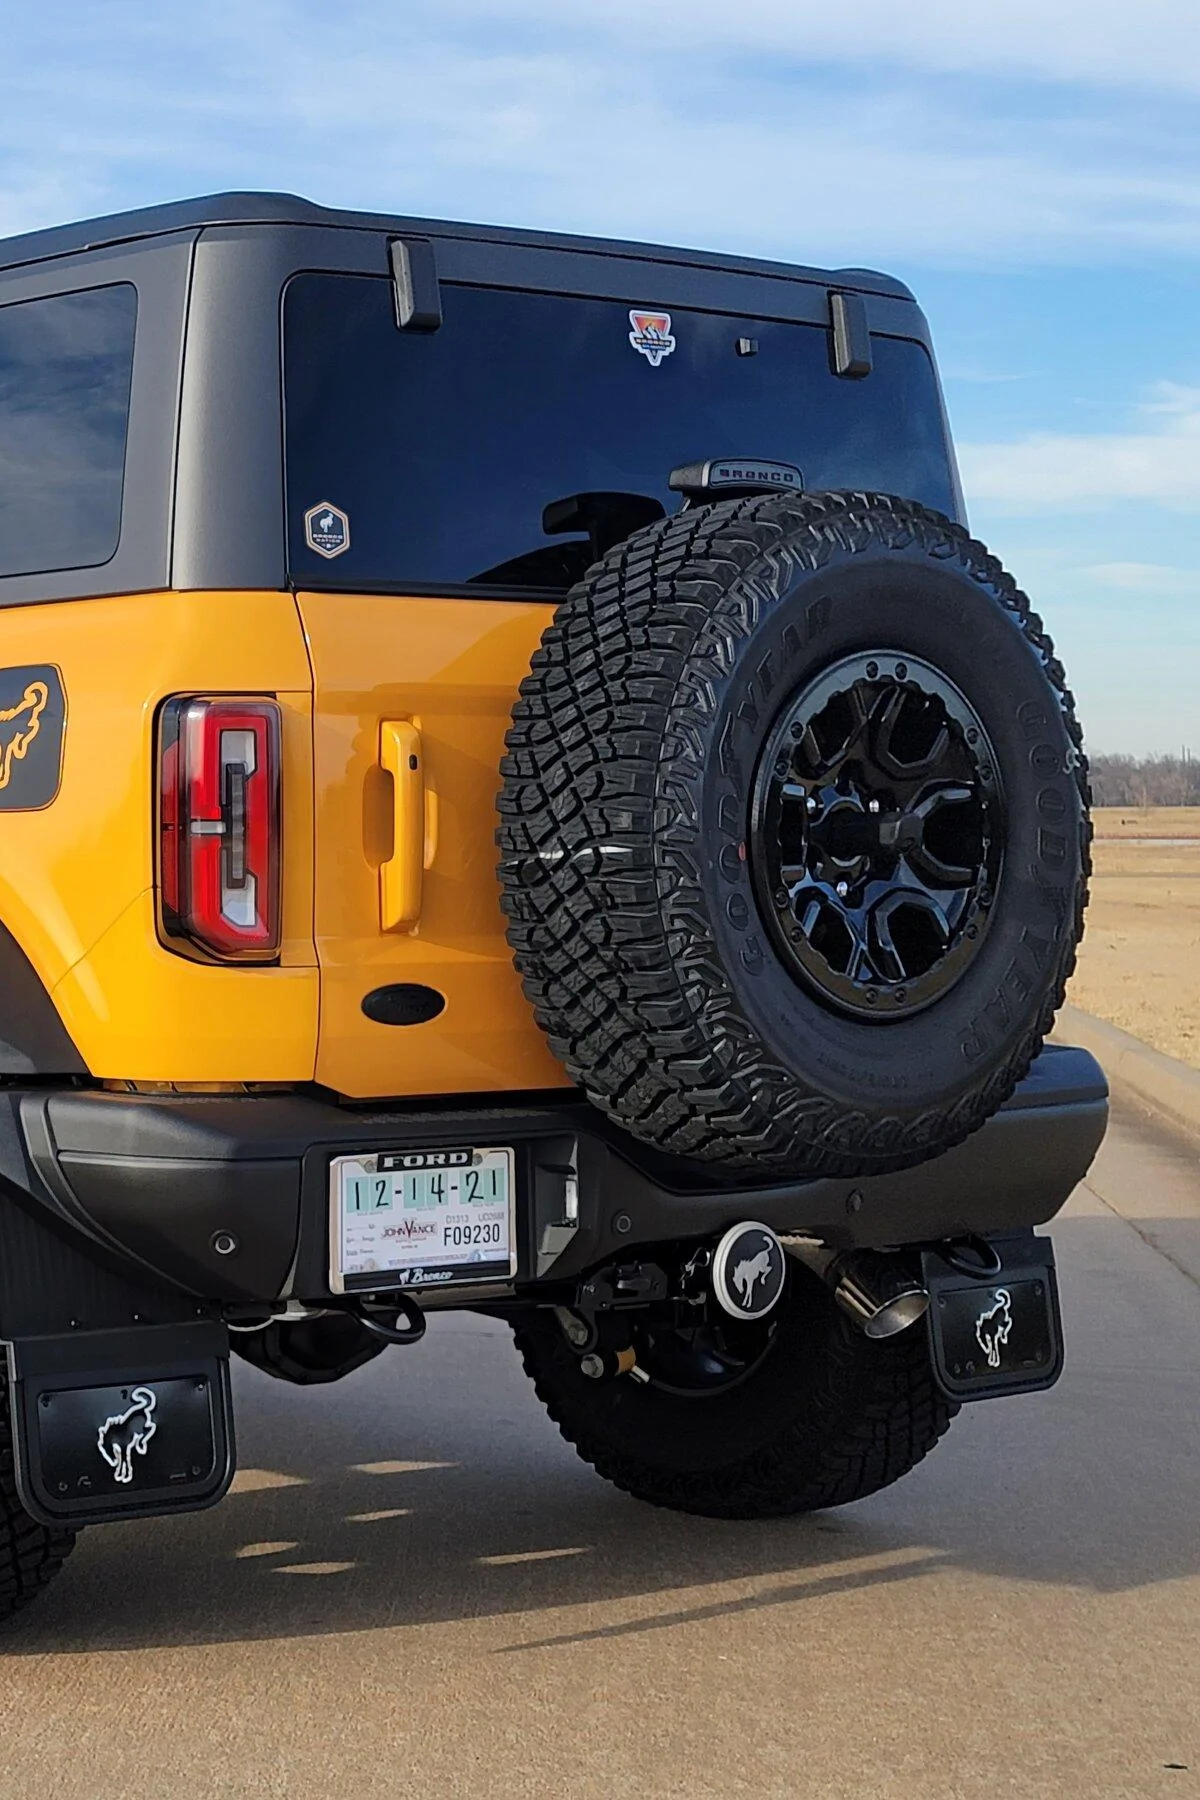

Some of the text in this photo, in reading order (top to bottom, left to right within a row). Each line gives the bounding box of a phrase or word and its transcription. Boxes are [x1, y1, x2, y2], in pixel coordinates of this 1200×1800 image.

[720, 469, 794, 482] BRONCO
[384, 1152, 468, 1168] FORD
[443, 1223, 501, 1247] F09230
[411, 1267, 454, 1284] Bronco
